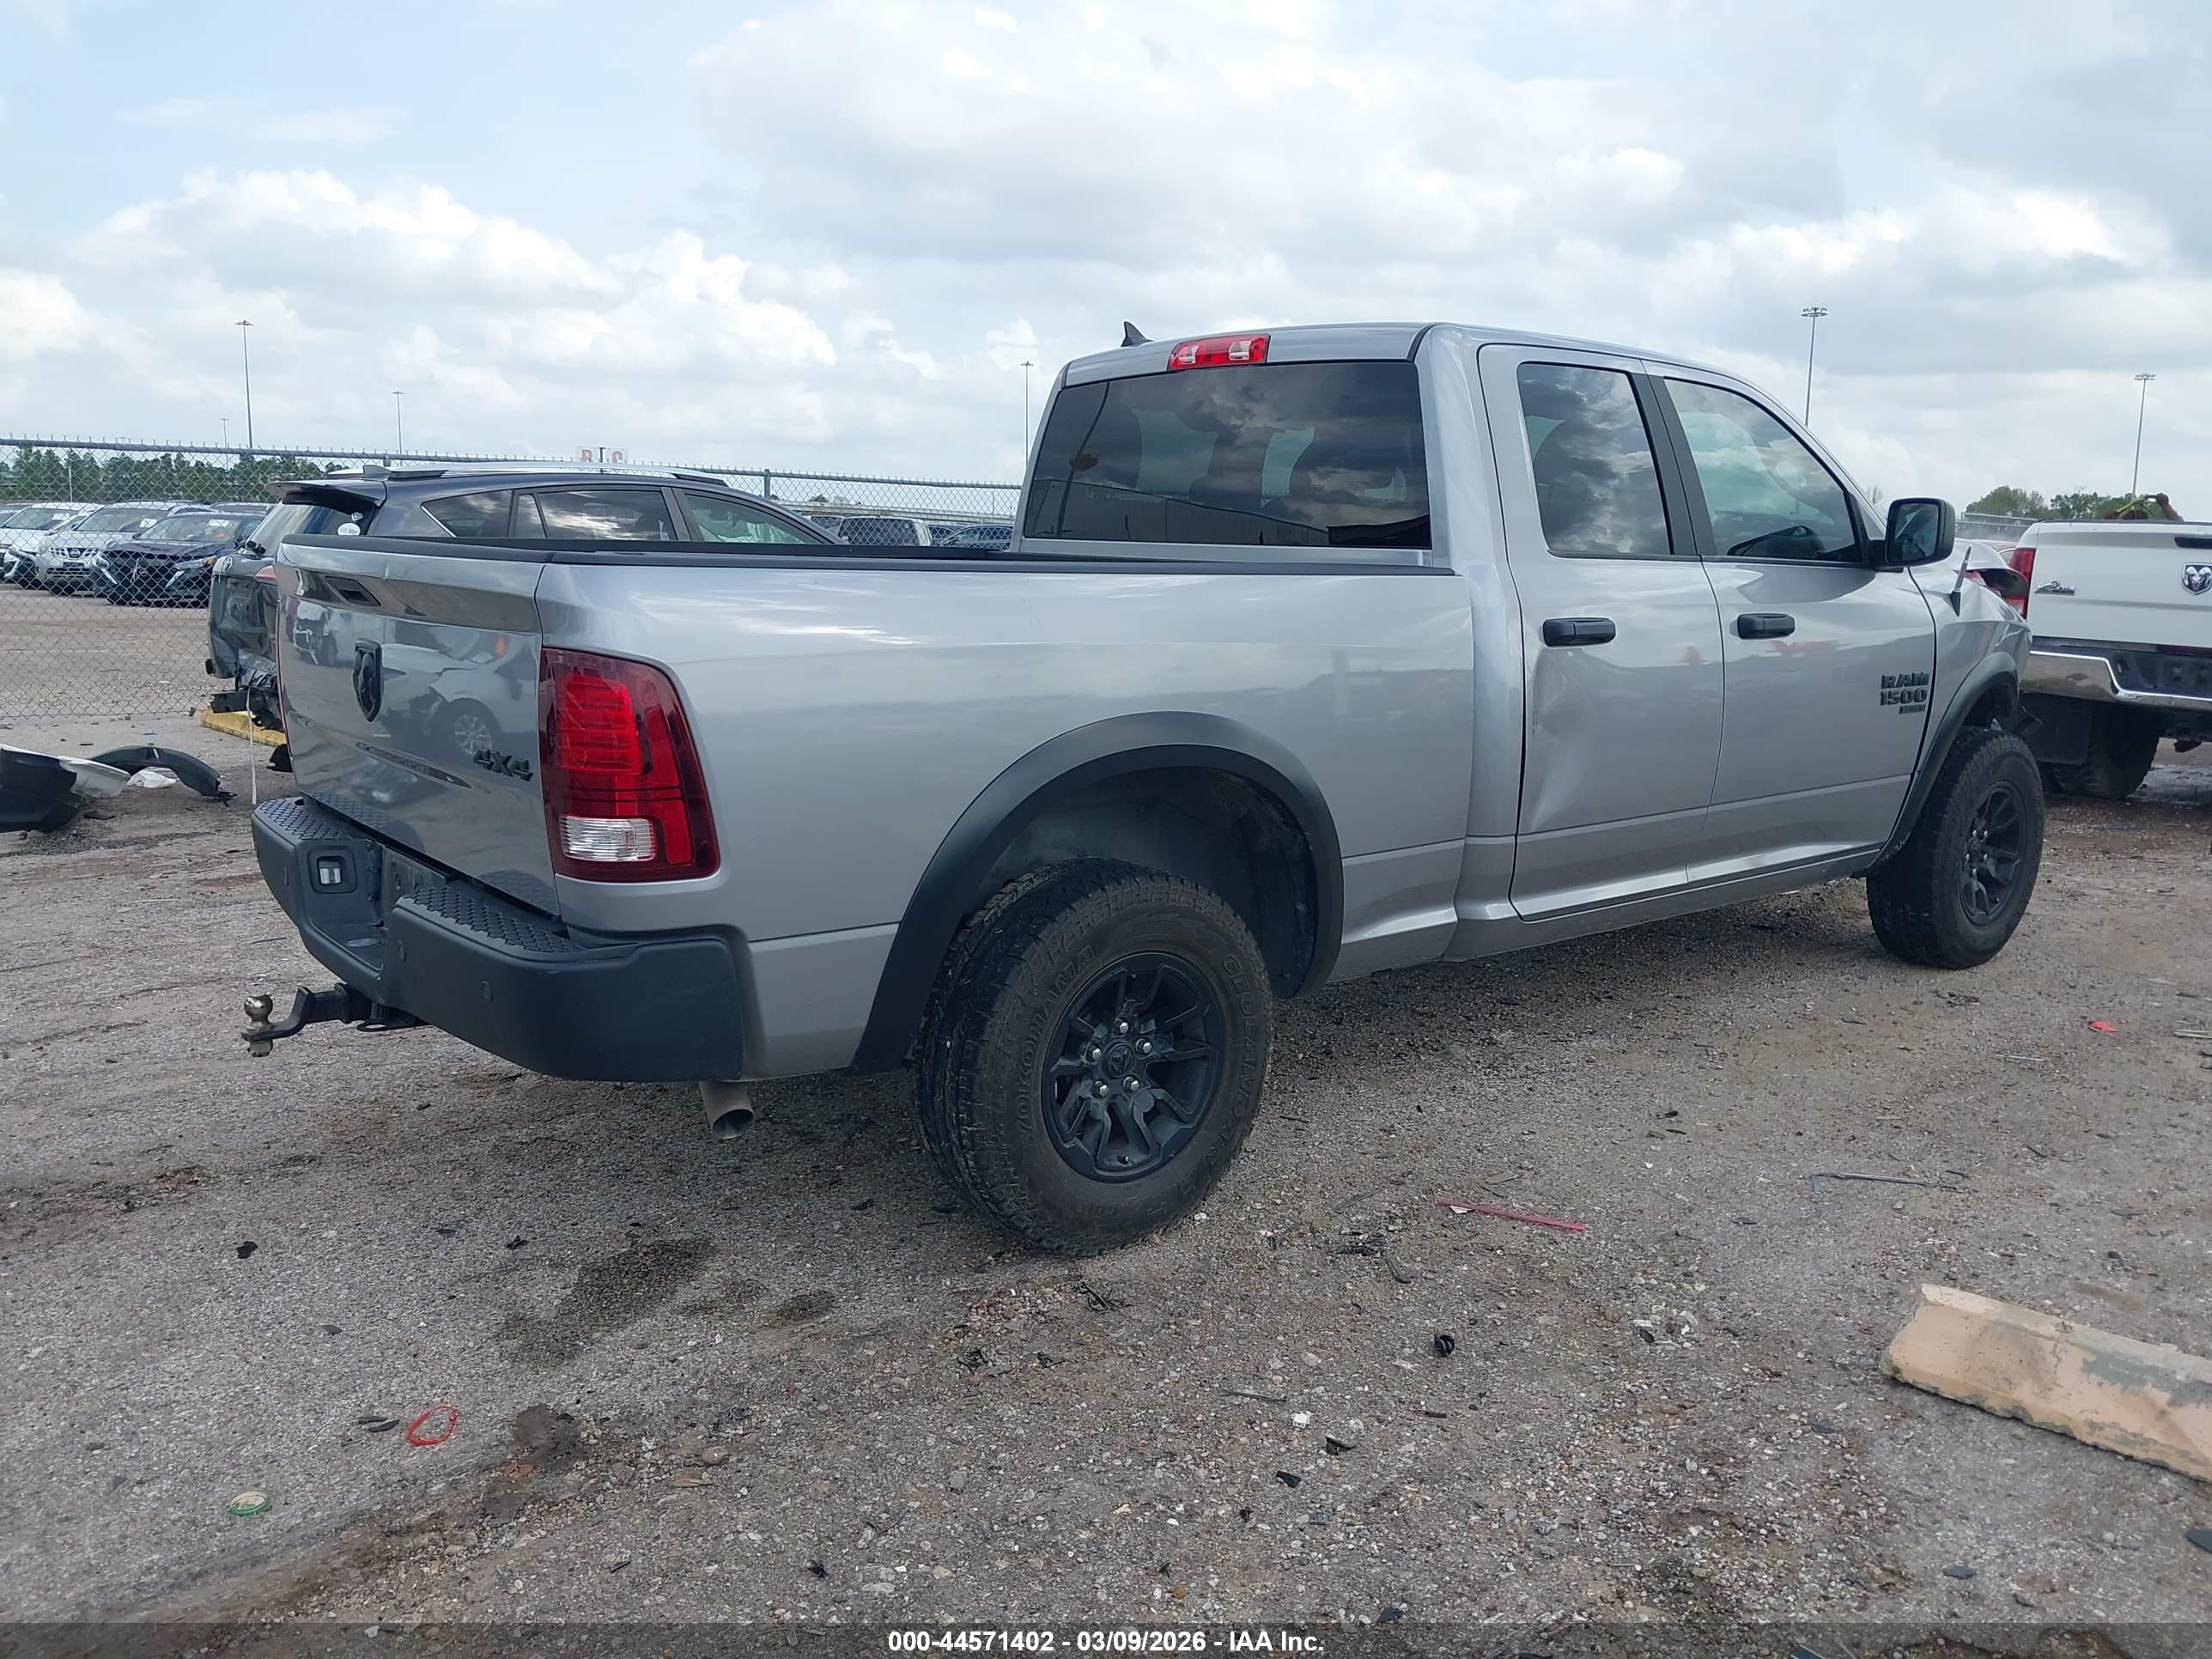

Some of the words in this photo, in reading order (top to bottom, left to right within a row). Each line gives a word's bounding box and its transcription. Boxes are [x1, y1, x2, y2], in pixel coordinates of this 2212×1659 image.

[1880, 688, 1928, 706] 1500
[1881, 671, 1930, 690] RAM
[1015, 944, 1097, 1143] YOKOHAMA
[1204, 953, 1259, 1165] GEOLANDAR
